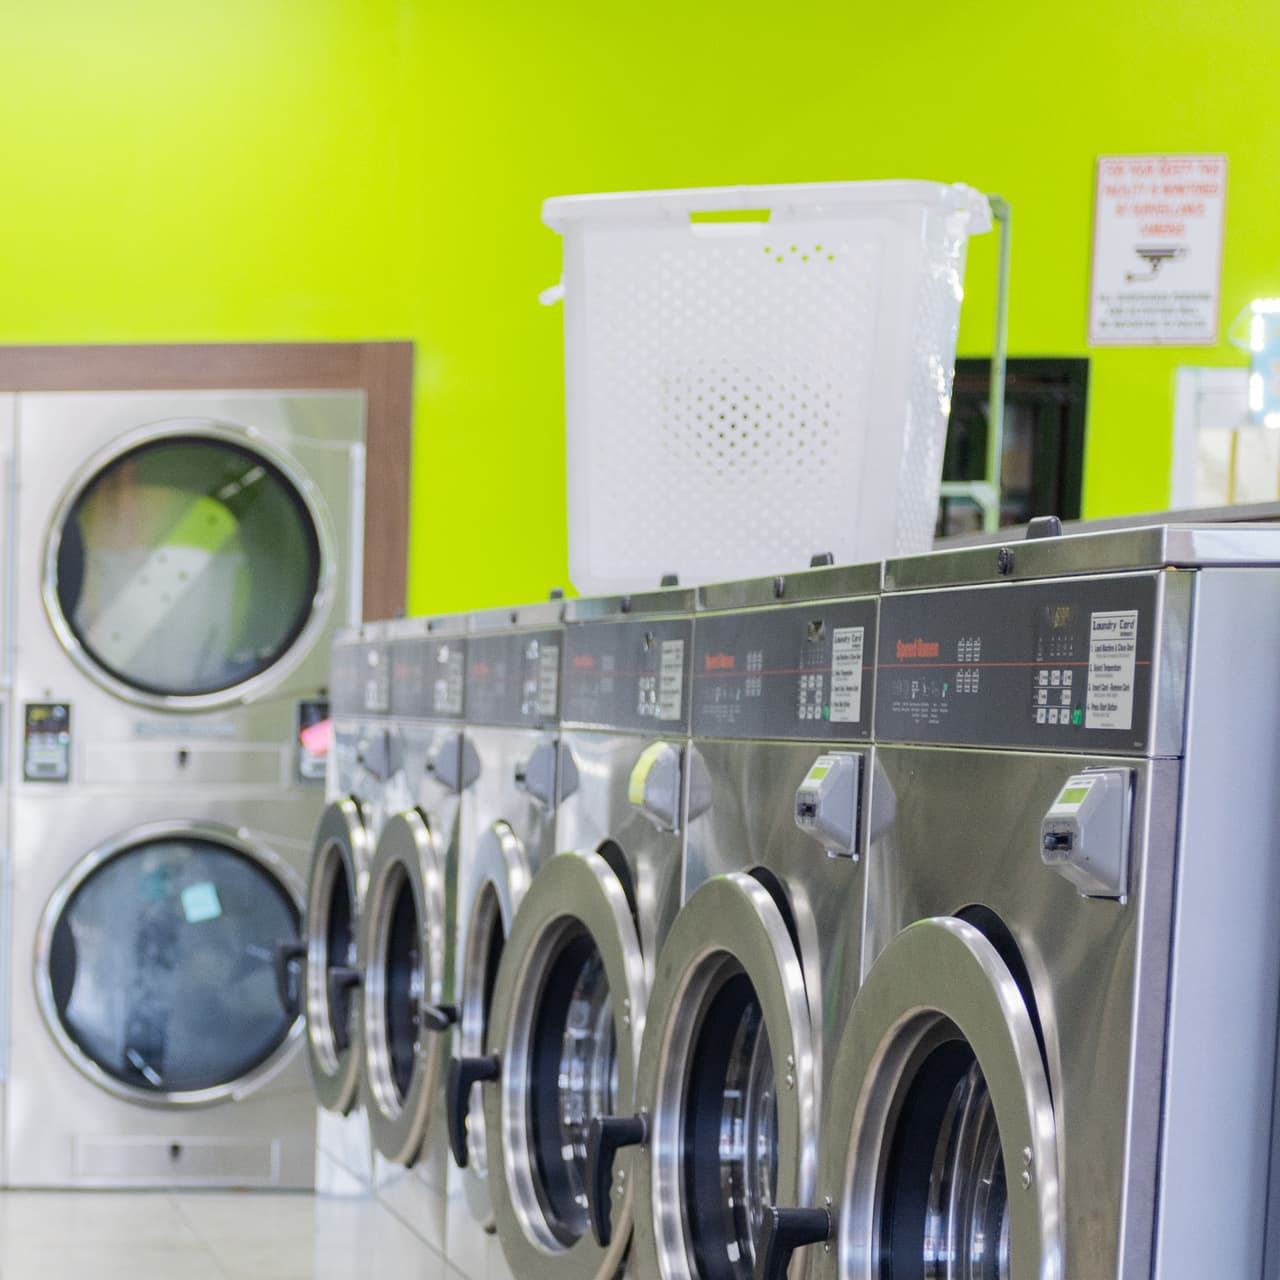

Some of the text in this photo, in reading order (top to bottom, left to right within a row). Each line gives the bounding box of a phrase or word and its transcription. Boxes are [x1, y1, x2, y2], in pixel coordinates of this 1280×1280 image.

[1093, 619, 1134, 631] Laundry Card
[896, 636, 939, 662] Speed Queen
